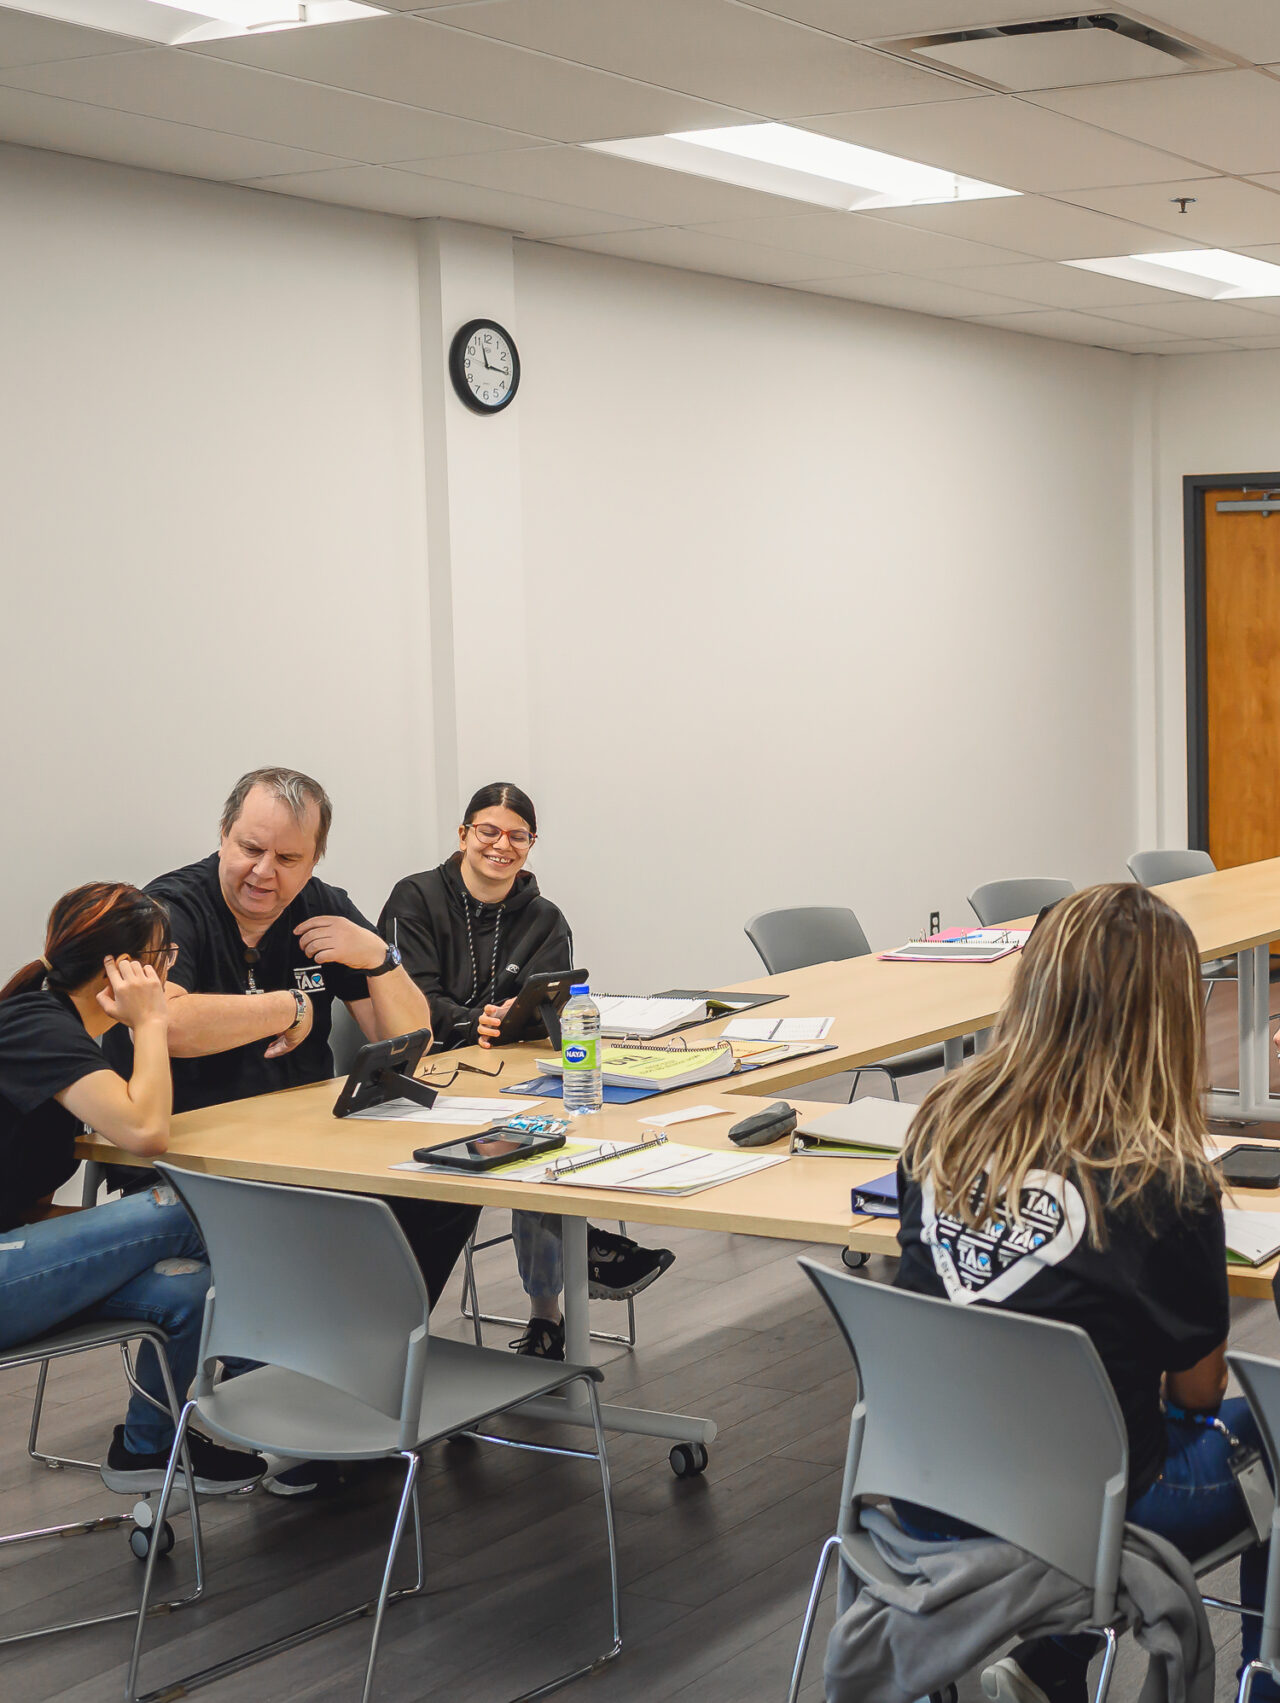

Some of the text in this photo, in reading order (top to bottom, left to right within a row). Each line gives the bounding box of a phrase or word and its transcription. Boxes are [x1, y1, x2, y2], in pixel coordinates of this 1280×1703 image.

[475, 336, 481, 346] 11
[484, 334, 492, 344] 12
[467, 345, 476, 356] 10
[500, 351, 507, 361] 2
[464, 359, 470, 368] 9
[503, 366, 509, 375] 3
[467, 374, 473, 383] 8
[474, 384, 481, 394] 7
[499, 380, 505, 390] 4
[483, 391, 489, 400] 6
[493, 388, 499, 398] 5
[295, 973, 325, 990] TAQ
[957, 1245, 992, 1271] TAQ
